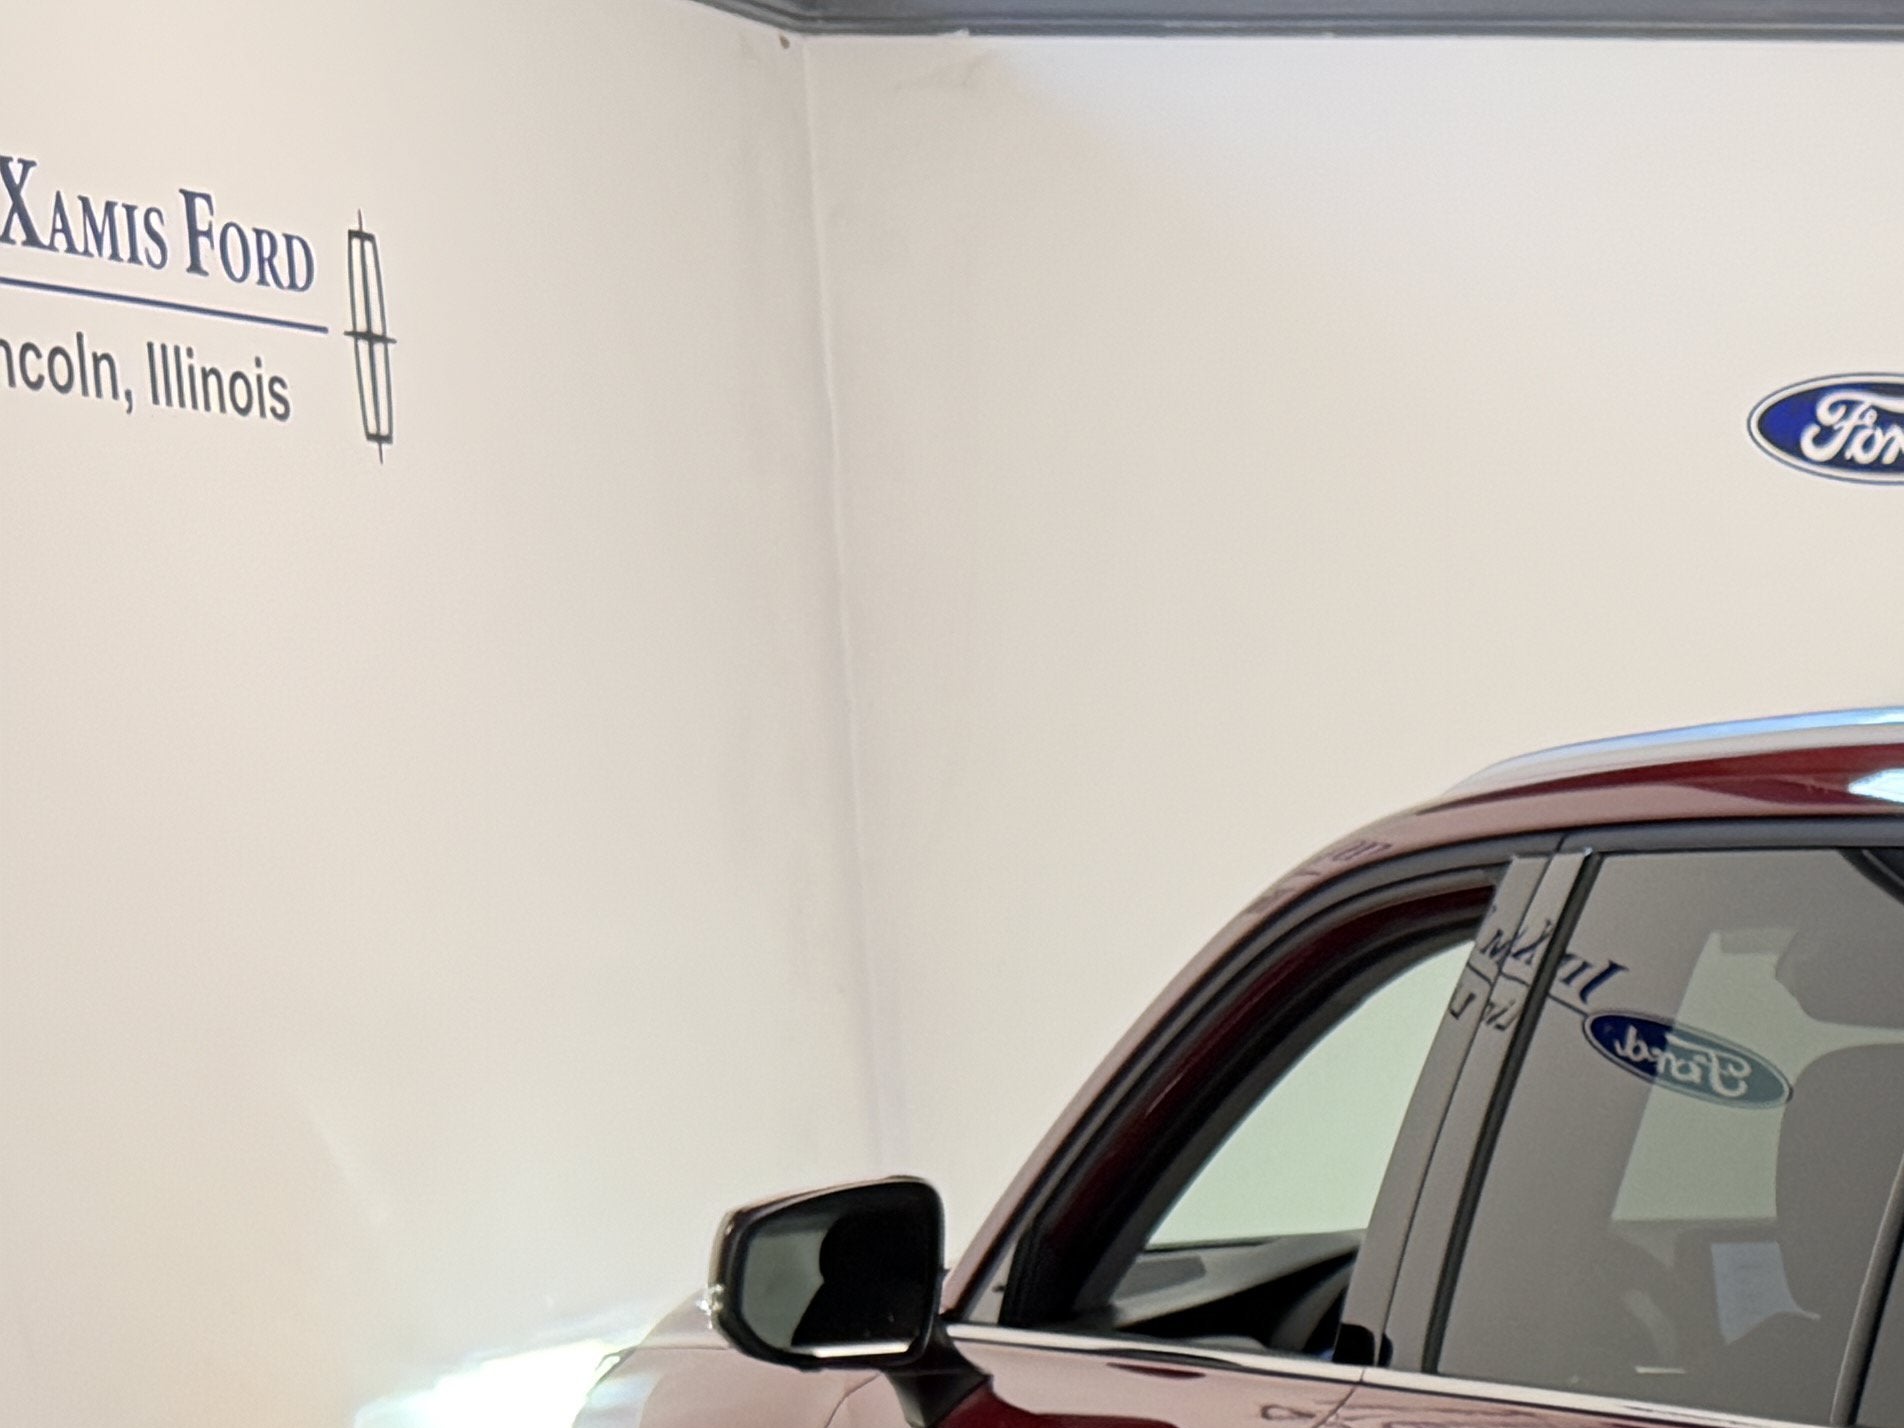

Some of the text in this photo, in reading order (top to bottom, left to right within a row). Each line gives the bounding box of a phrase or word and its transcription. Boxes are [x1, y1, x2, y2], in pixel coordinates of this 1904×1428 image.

[0, 155, 315, 293] XAMIS FORD
[147, 341, 291, 422] Illinois
